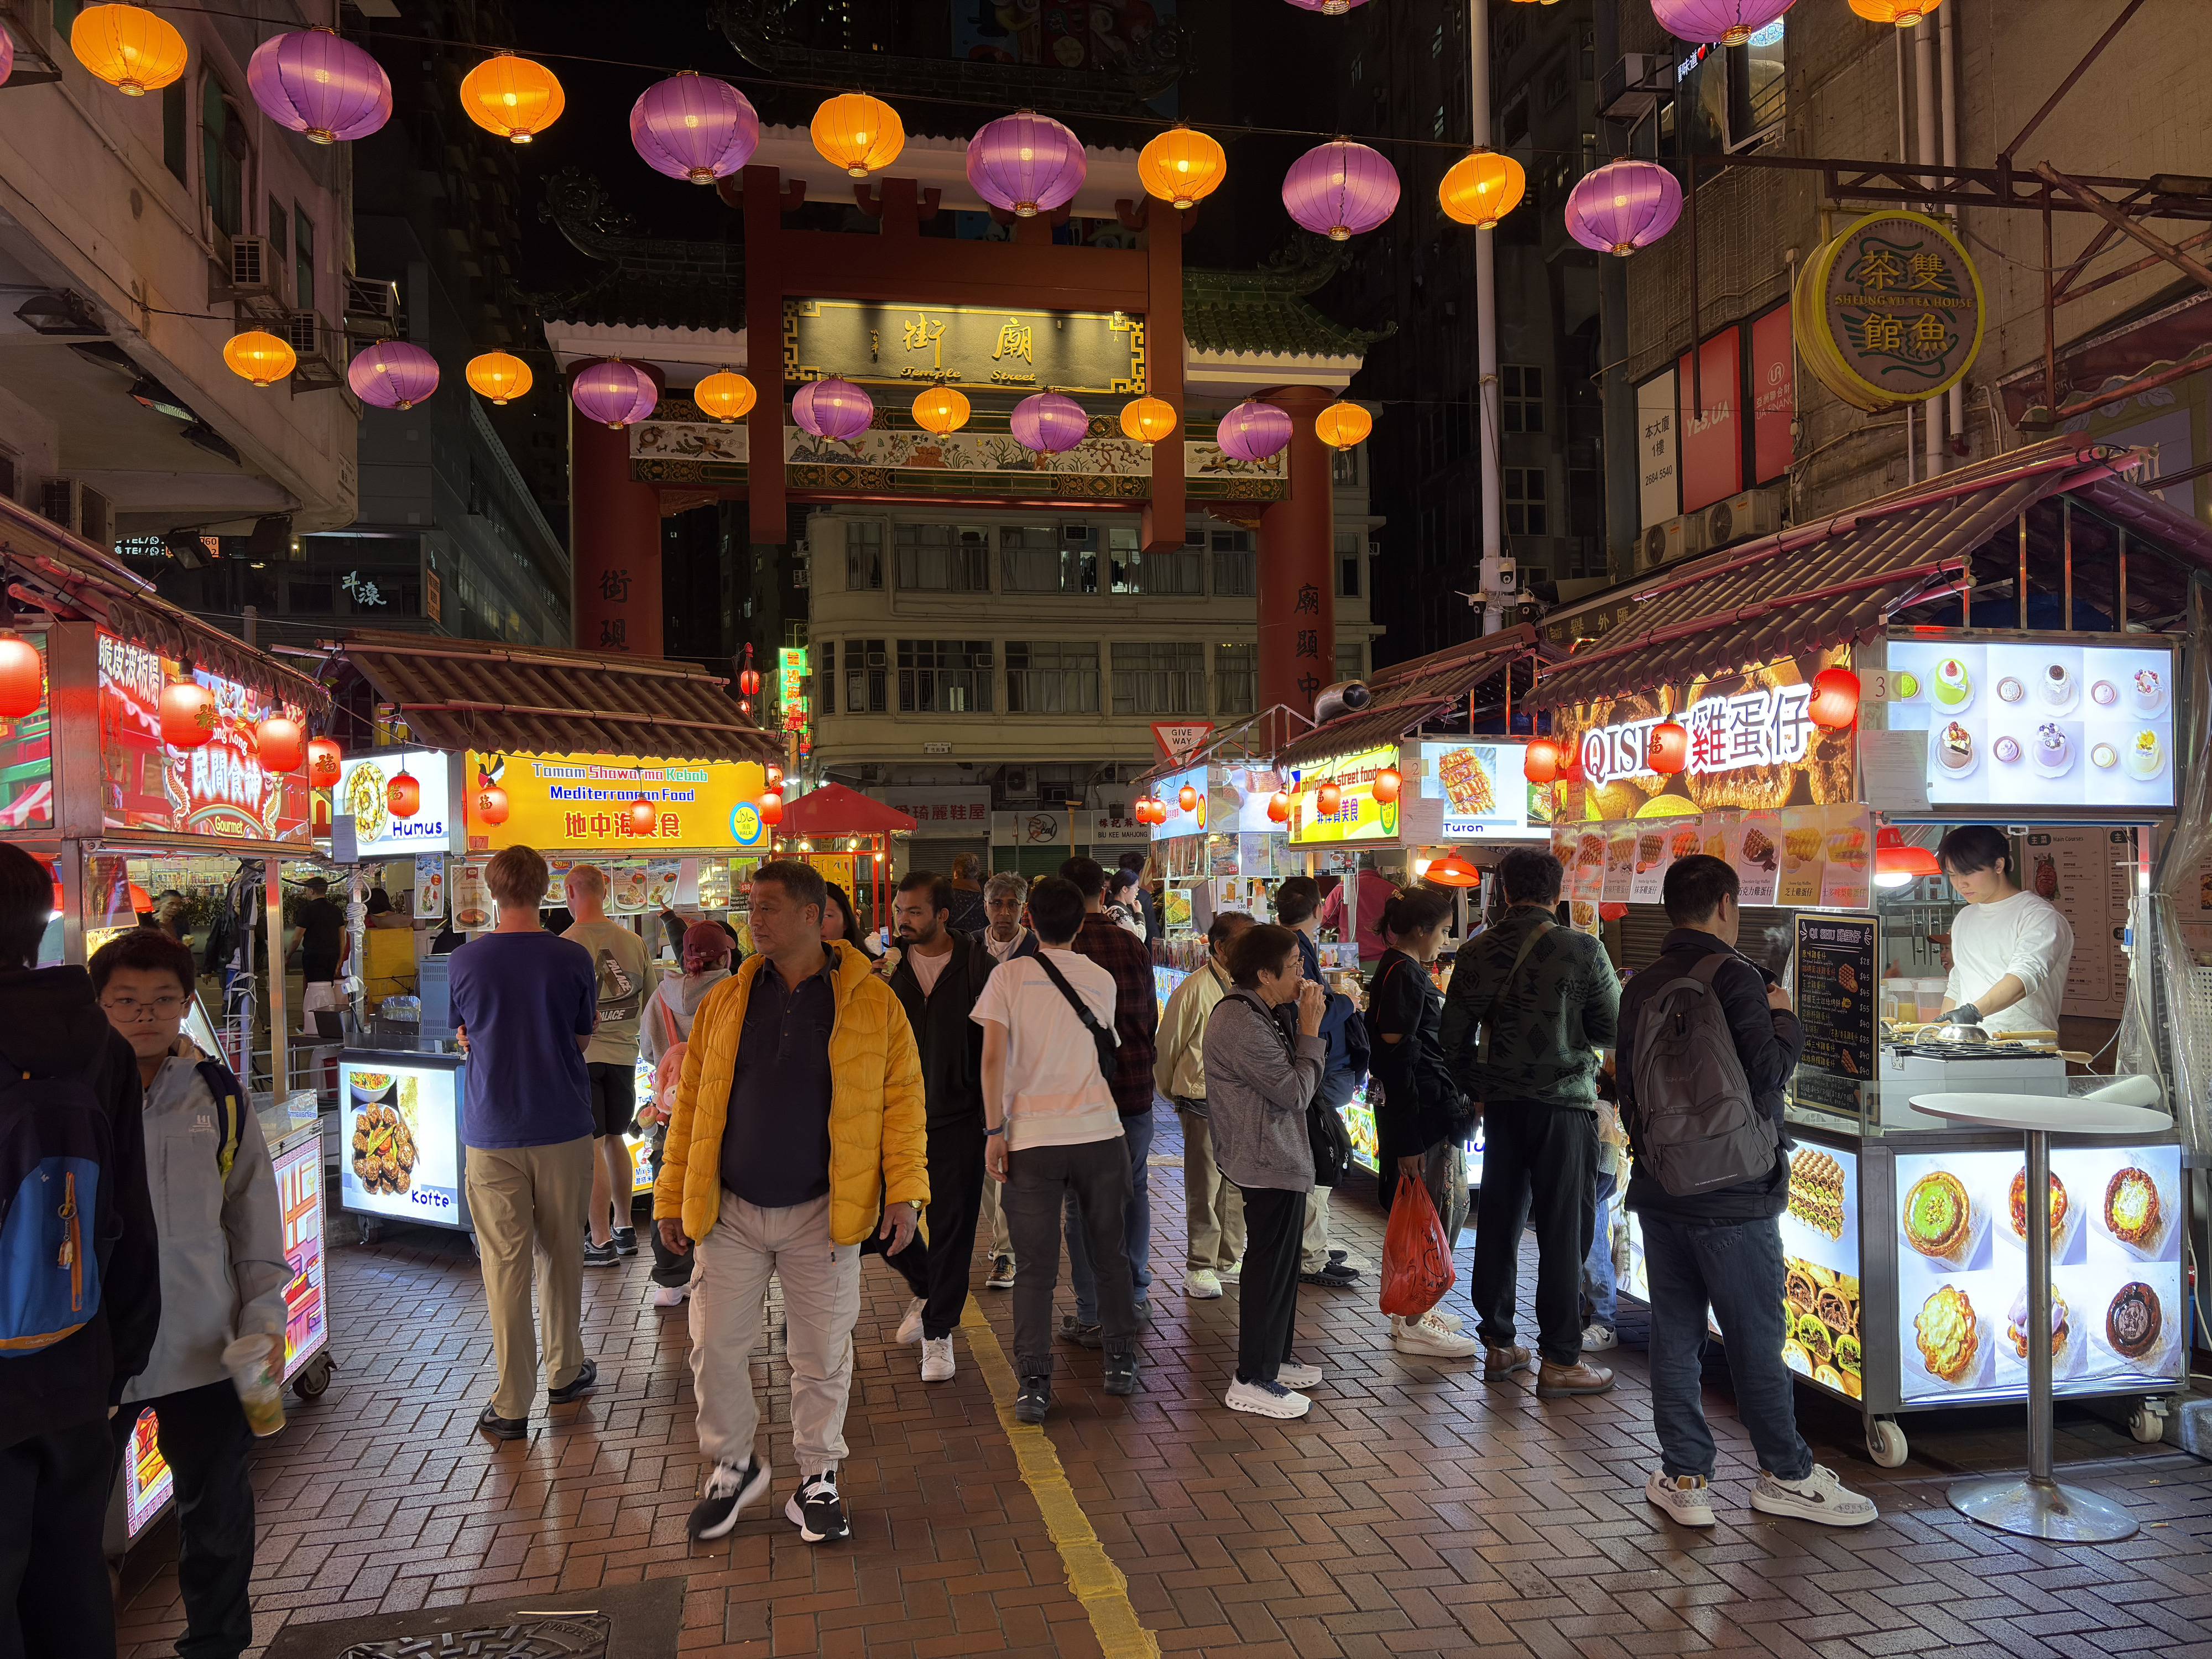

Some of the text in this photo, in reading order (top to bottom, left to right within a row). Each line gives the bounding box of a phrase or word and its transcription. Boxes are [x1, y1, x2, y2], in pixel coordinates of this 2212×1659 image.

[1835, 294, 1973, 309] SHEUNG YU TEA HOUSE
[901, 367, 1036, 381] Temple Street
[1645, 415, 1670, 439] 本大廈
[1651, 439, 1665, 457] 1樓
[1645, 465, 1673, 486] 2684 5540
[98, 634, 160, 710] 脆皮波板腸
[1876, 676, 1885, 697] 3
[1692, 693, 1813, 769] 雞蛋仔
[211, 728, 248, 757] ong Kong
[315, 753, 337, 773] 福
[1412, 762, 1420, 775] 2
[532, 763, 708, 782] Tamam Shawarma Kebab
[1337, 768, 1359, 787] street
[388, 783, 404, 801] 福
[662, 789, 694, 801] Food
[479, 795, 492, 811] 福
[736, 810, 755, 823] حلال
[215, 816, 244, 836] Gourmet
[393, 821, 442, 836] Humus
[564, 811, 682, 840] 地中海食
[1443, 822, 1484, 832] Turon
[473, 837, 484, 848] 17
[1634, 885, 1657, 894] 抹茶雞蛋仔
[1785, 888, 1813, 896] 芝士雞蛋仔
[1809, 927, 1861, 943] QI SHU 雞蛋仔
[1860, 957, 1870, 966] $28
[606, 959, 632, 992] PALACE
[1860, 972, 1870, 981] $45
[1860, 988, 1870, 997] $45
[1860, 1003, 1870, 1013] $55
[1859, 1019, 1870, 1029] $40
[1859, 1035, 1870, 1044] $35
[1859, 1050, 1870, 1060] $40
[1859, 1066, 1870, 1076] $40
[635, 1167, 646, 1176] Mix
[412, 1190, 449, 1208] Kofte
